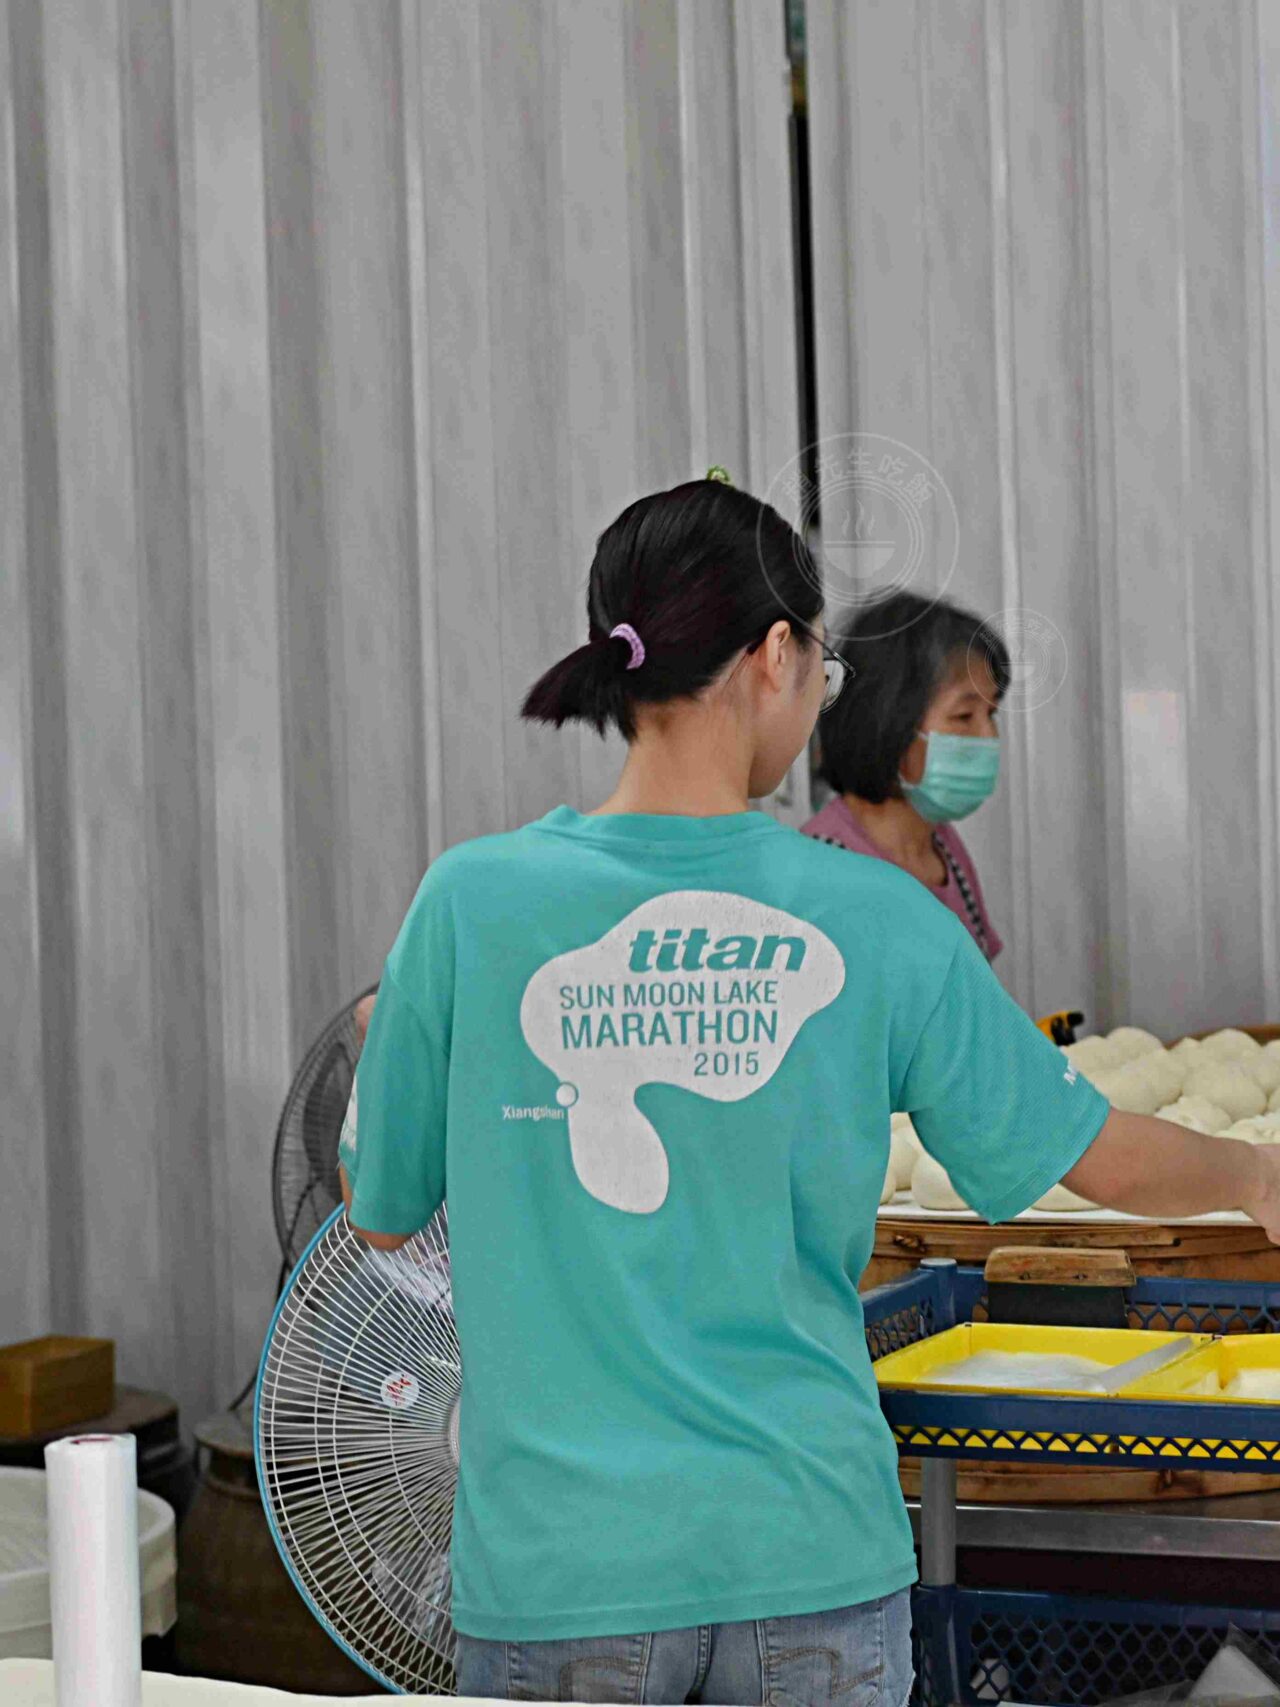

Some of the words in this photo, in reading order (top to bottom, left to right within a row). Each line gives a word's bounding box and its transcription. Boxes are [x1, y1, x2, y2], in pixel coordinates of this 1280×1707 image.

[628, 927, 808, 975] titan
[559, 984, 616, 1009] SUN
[623, 982, 706, 1008] MOON
[712, 979, 779, 1005] LAKE
[560, 1010, 778, 1049] MARATHON
[693, 1051, 761, 1077] 2015
[502, 1104, 565, 1122] Xiangshan
